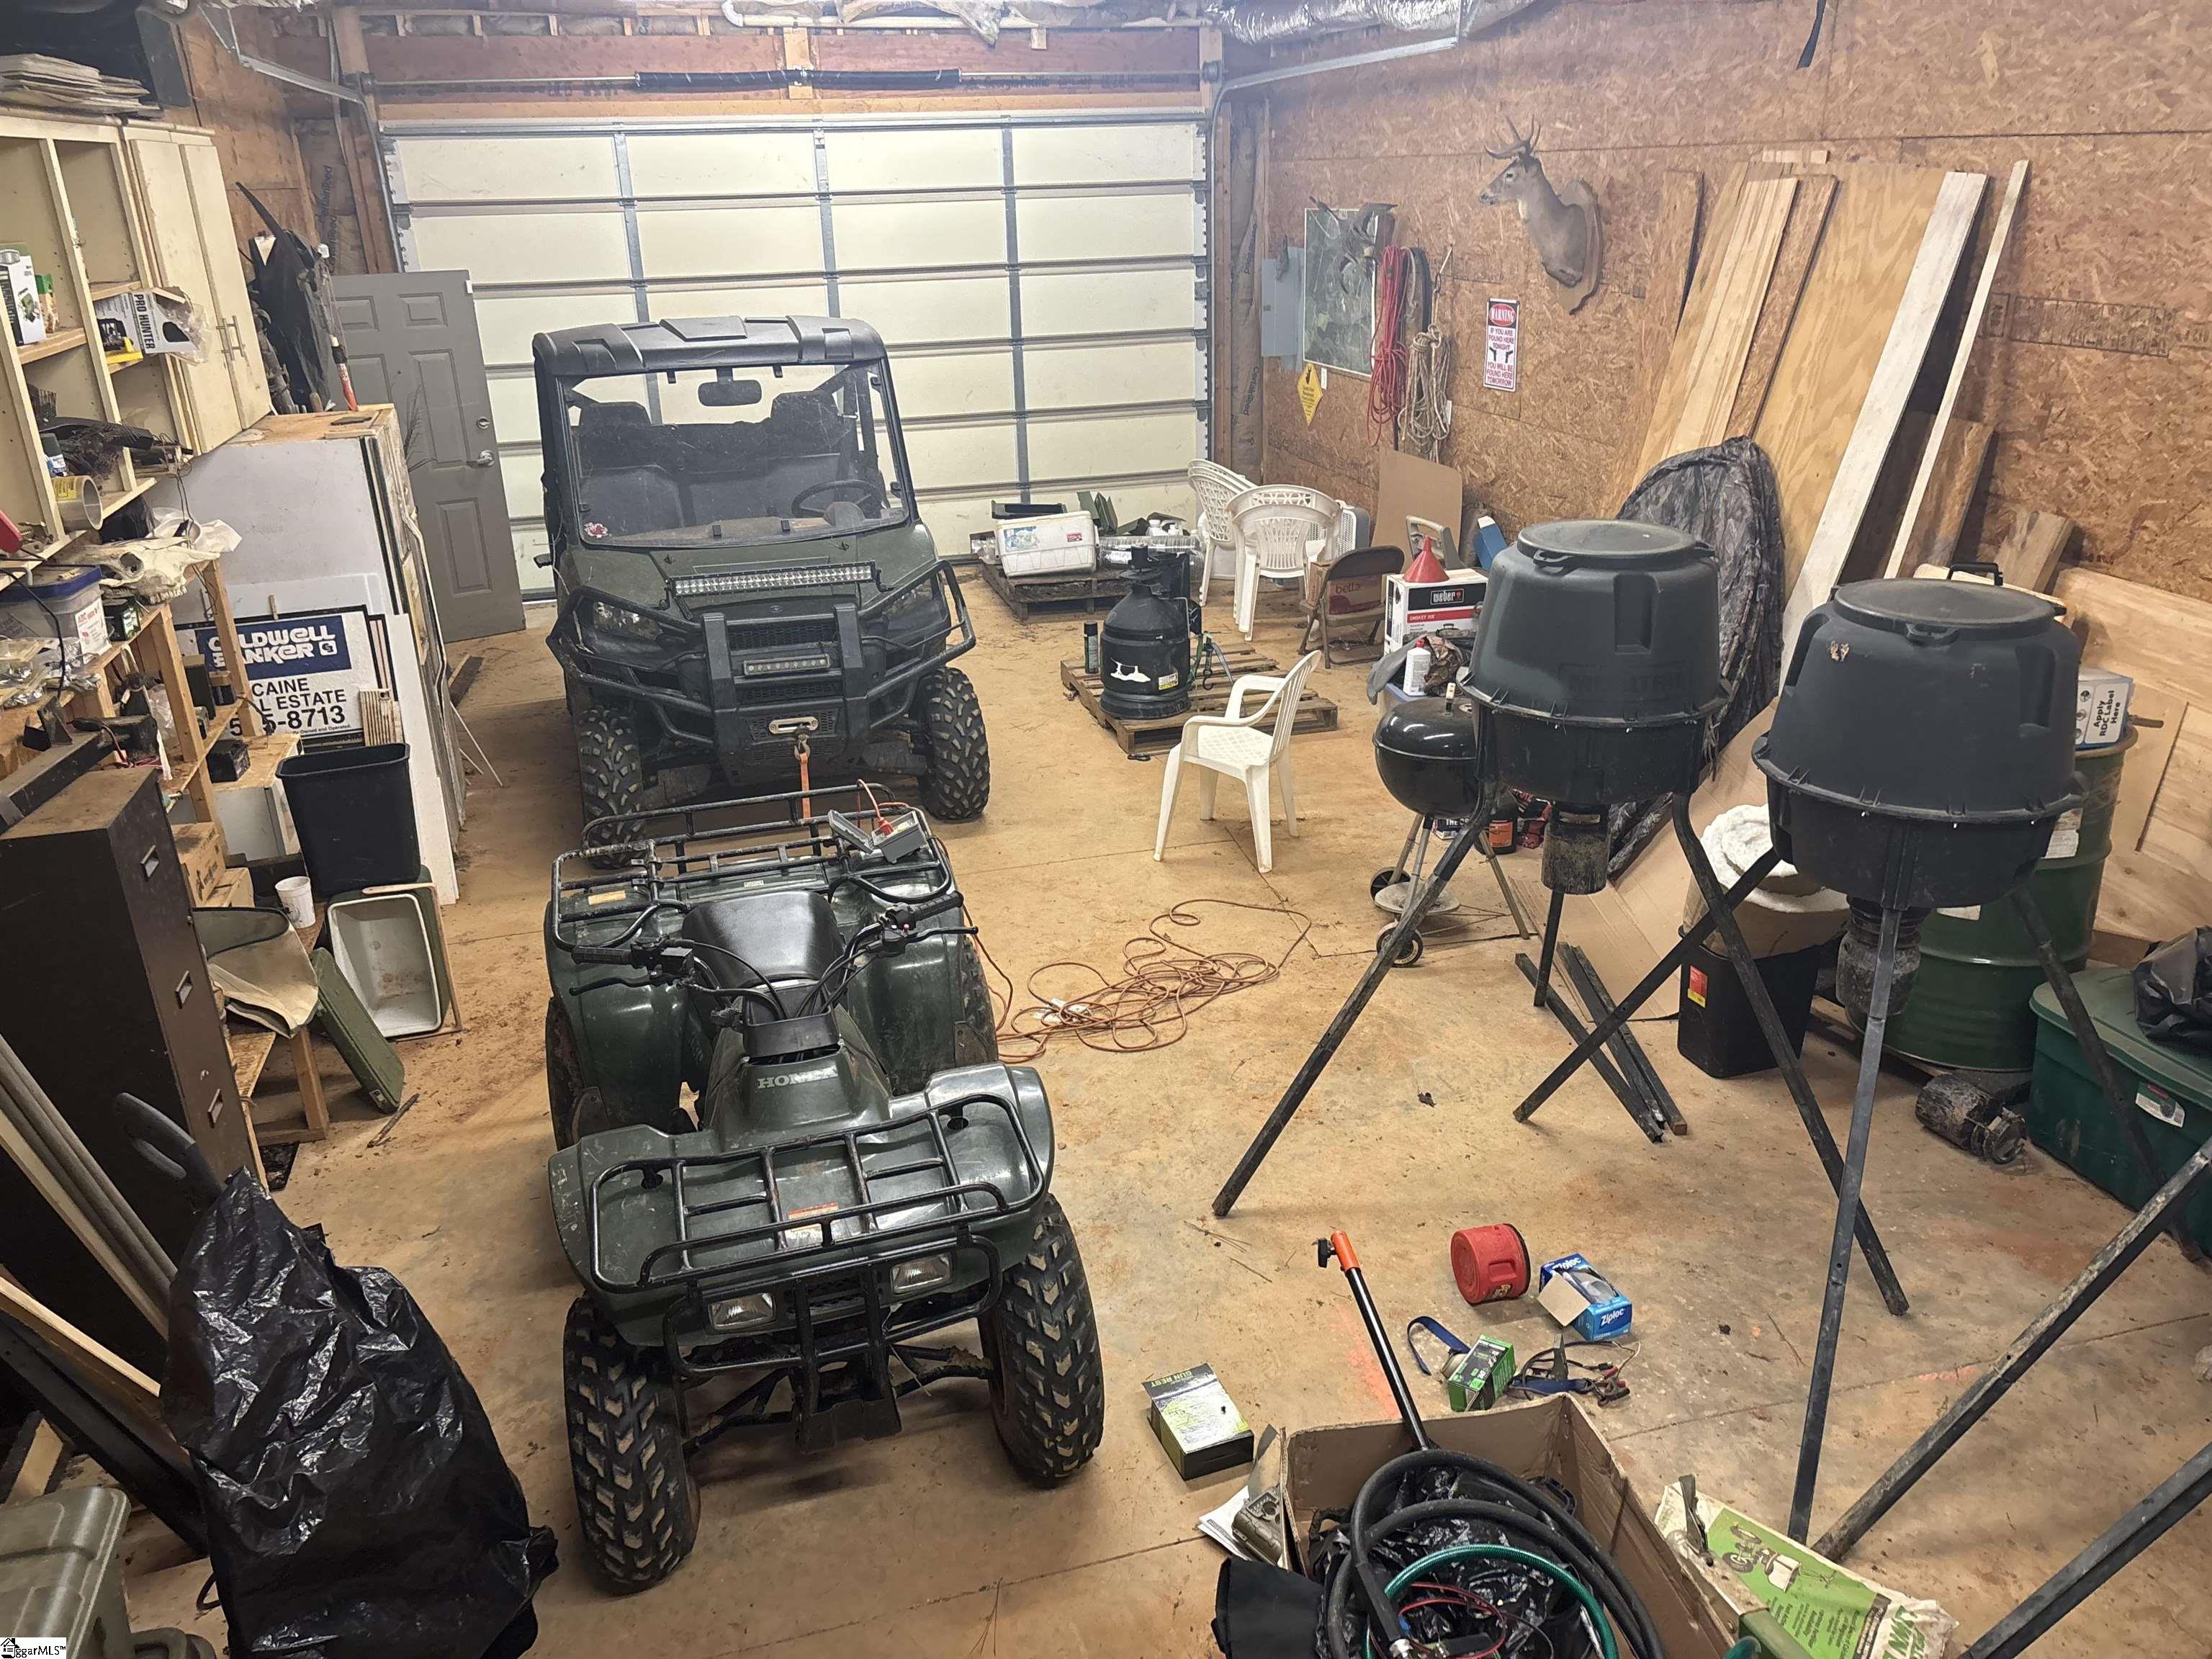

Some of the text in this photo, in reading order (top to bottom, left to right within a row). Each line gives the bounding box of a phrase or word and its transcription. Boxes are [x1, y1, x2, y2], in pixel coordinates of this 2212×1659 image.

[133, 294, 147, 313] PRO
[1491, 307, 1516, 323] WARNING
[138, 314, 156, 349] HUNTER
[1486, 369, 1513, 379] FOUND HERE
[1487, 376, 1511, 387] TOMORROW
[208, 625, 336, 651] CLDWELL
[214, 644, 315, 667] BNKER
[252, 678, 310, 697] CAINE
[276, 689, 347, 709] ESTATE
[230, 706, 346, 737] 55-8713
[2093, 701, 2105, 727] Apply
[2099, 690, 2115, 736] RDC Label
[2110, 702, 2121, 724] Here
[757, 1065, 838, 1089] HONDA
[1600, 1308, 1625, 1326] Ziploc
[1151, 1370, 1193, 1387] GUN REST
